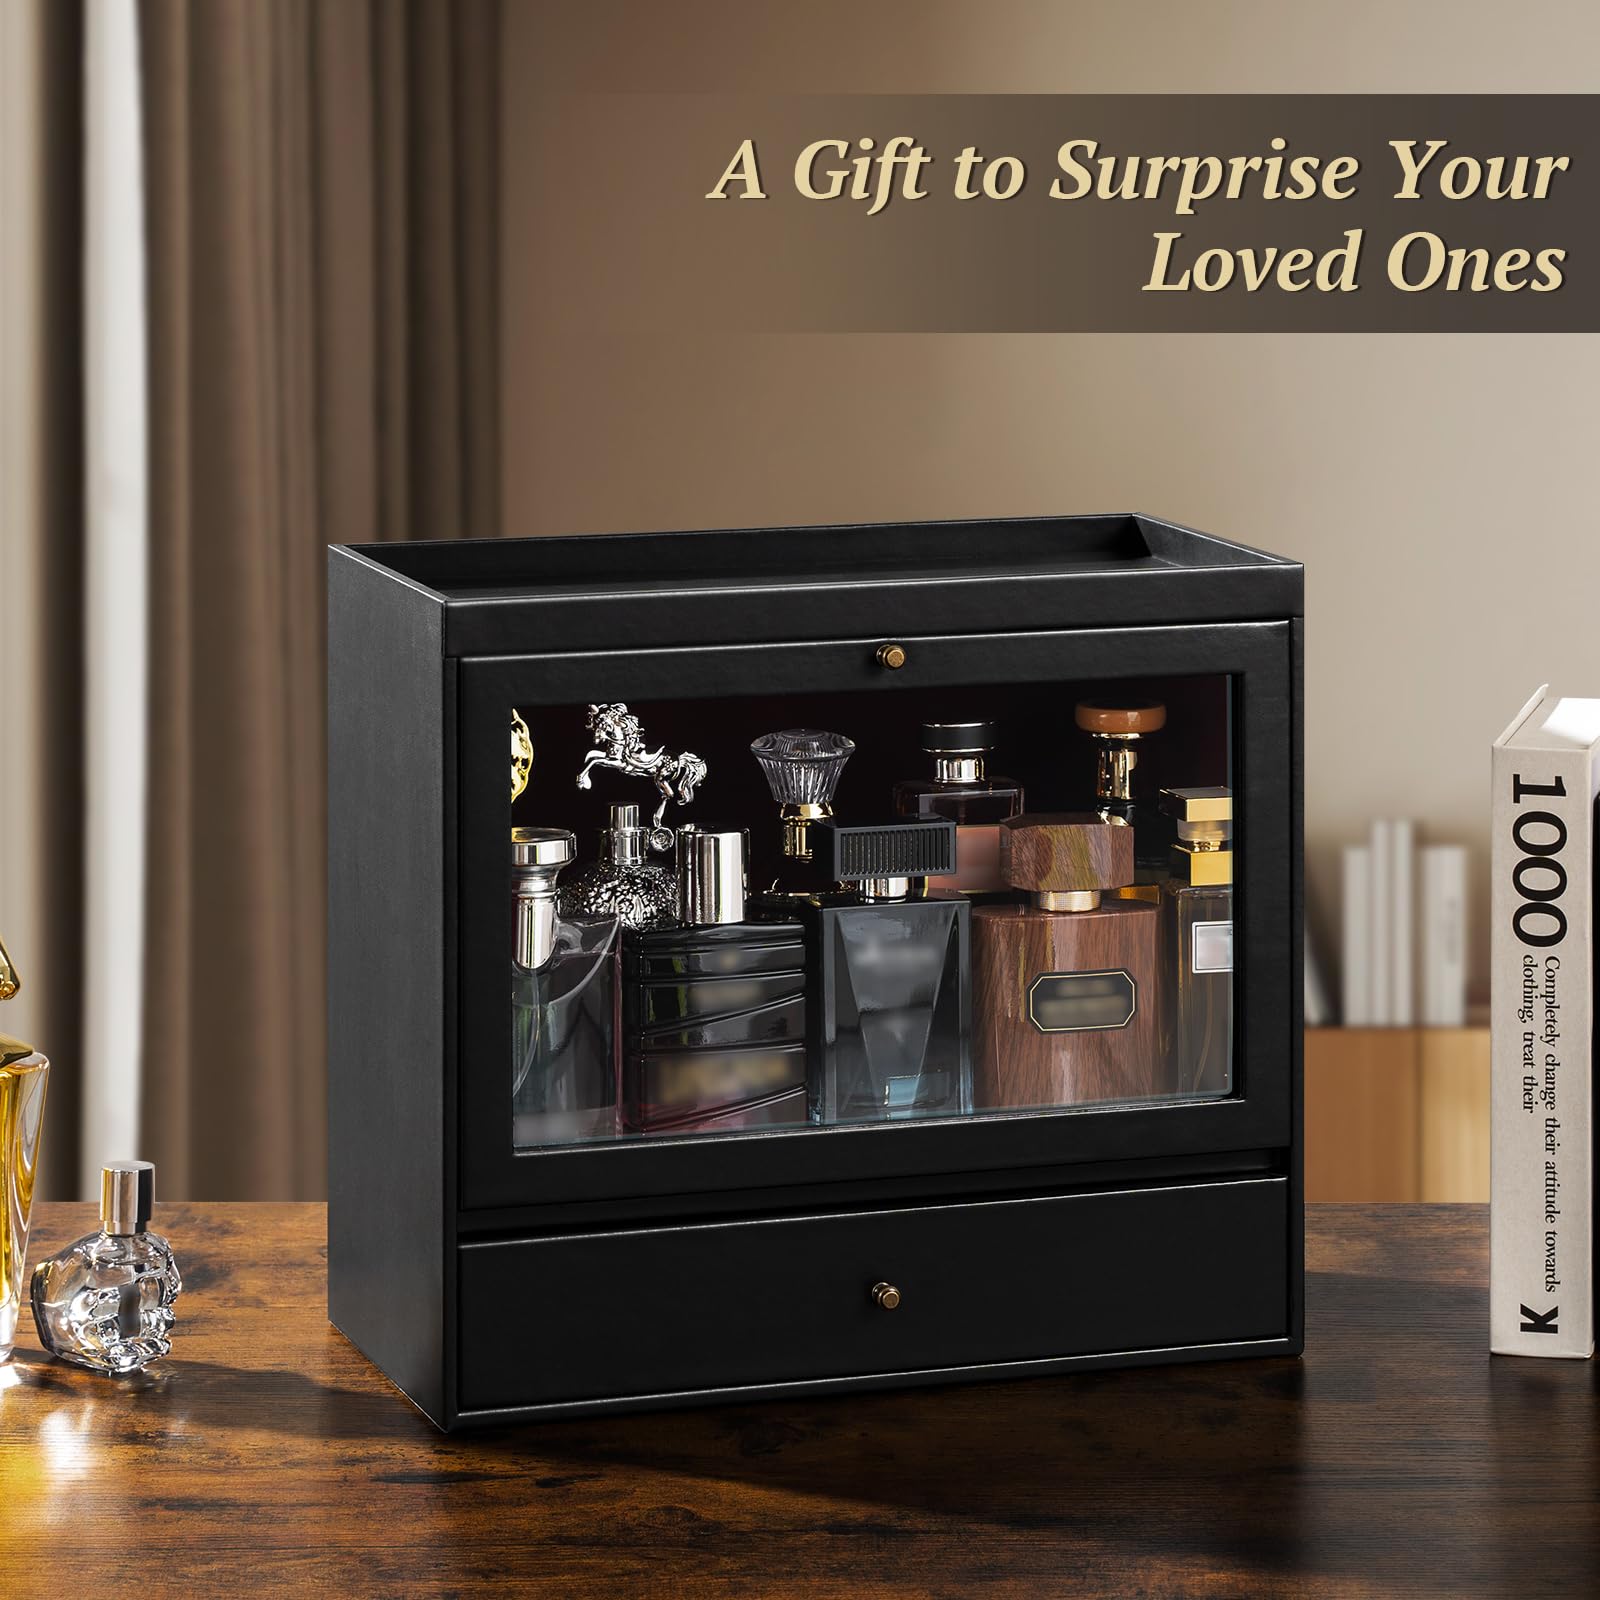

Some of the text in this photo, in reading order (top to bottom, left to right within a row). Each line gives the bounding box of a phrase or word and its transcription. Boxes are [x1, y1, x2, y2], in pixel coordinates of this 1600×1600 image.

[1511, 773, 1568, 948] 1000
[1517, 954, 1539, 1114] clothing, treat their
[1540, 955, 1561, 1293] Completely change their attitude towards
[1519, 1303, 1559, 1335] K
